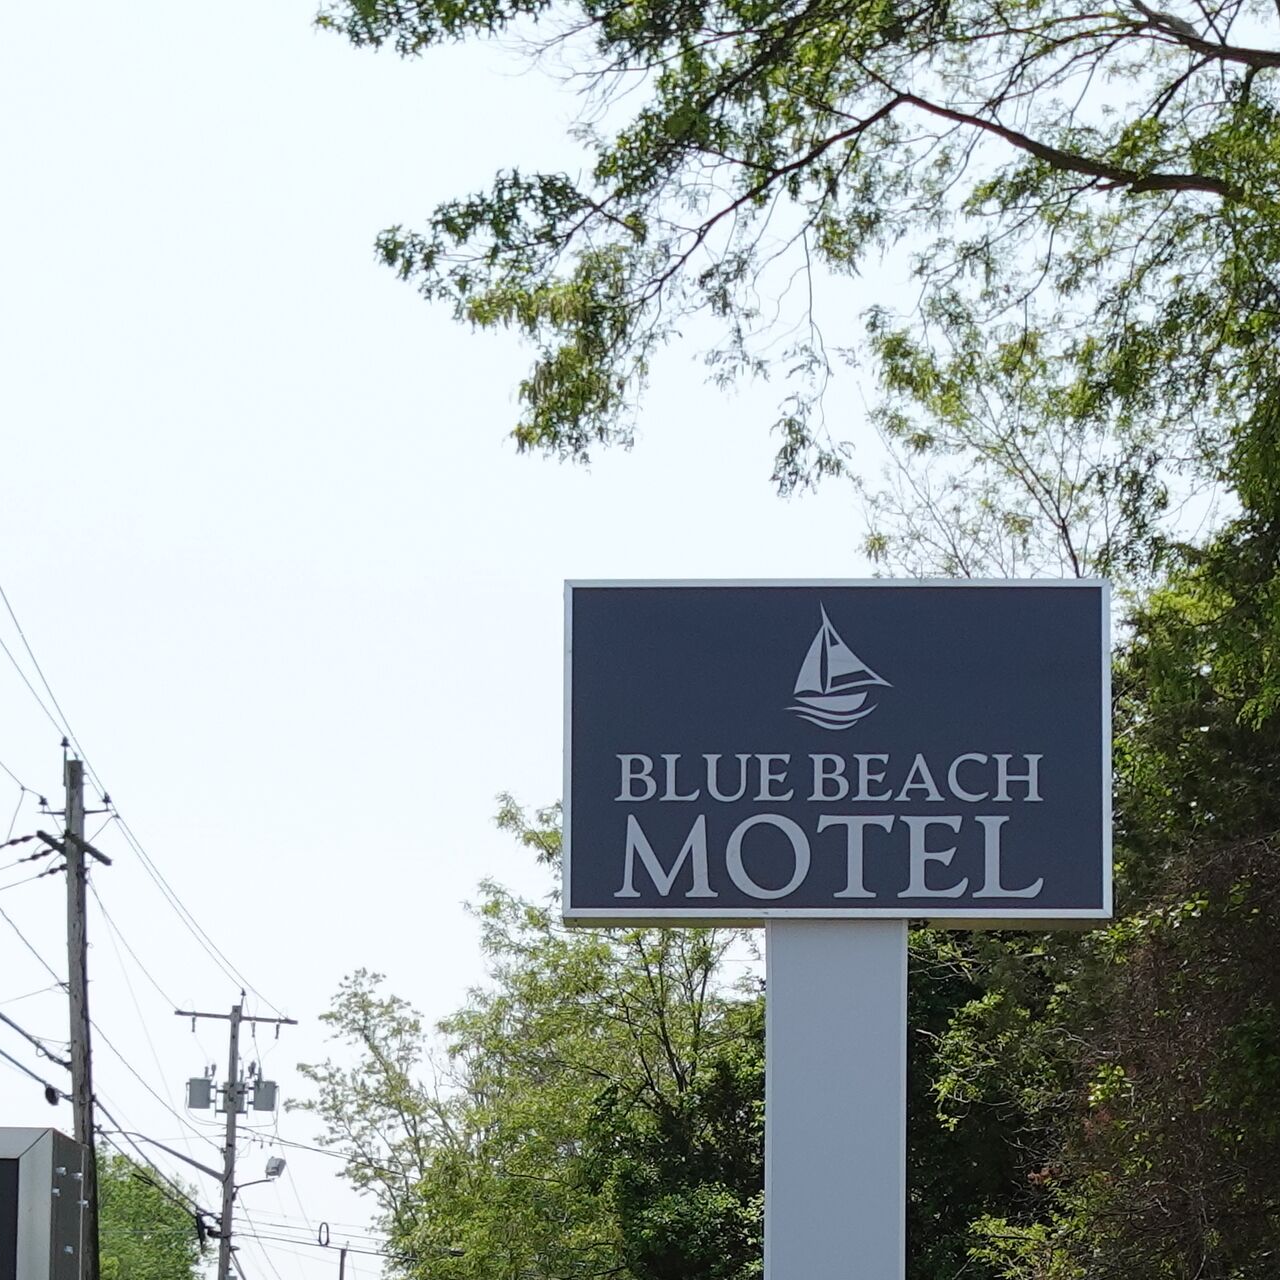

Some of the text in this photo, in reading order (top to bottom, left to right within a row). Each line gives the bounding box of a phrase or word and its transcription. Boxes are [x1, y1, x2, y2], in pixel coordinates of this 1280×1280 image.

[614, 752, 1044, 802] BLUE BEACH
[613, 813, 1044, 900] MOTEL
